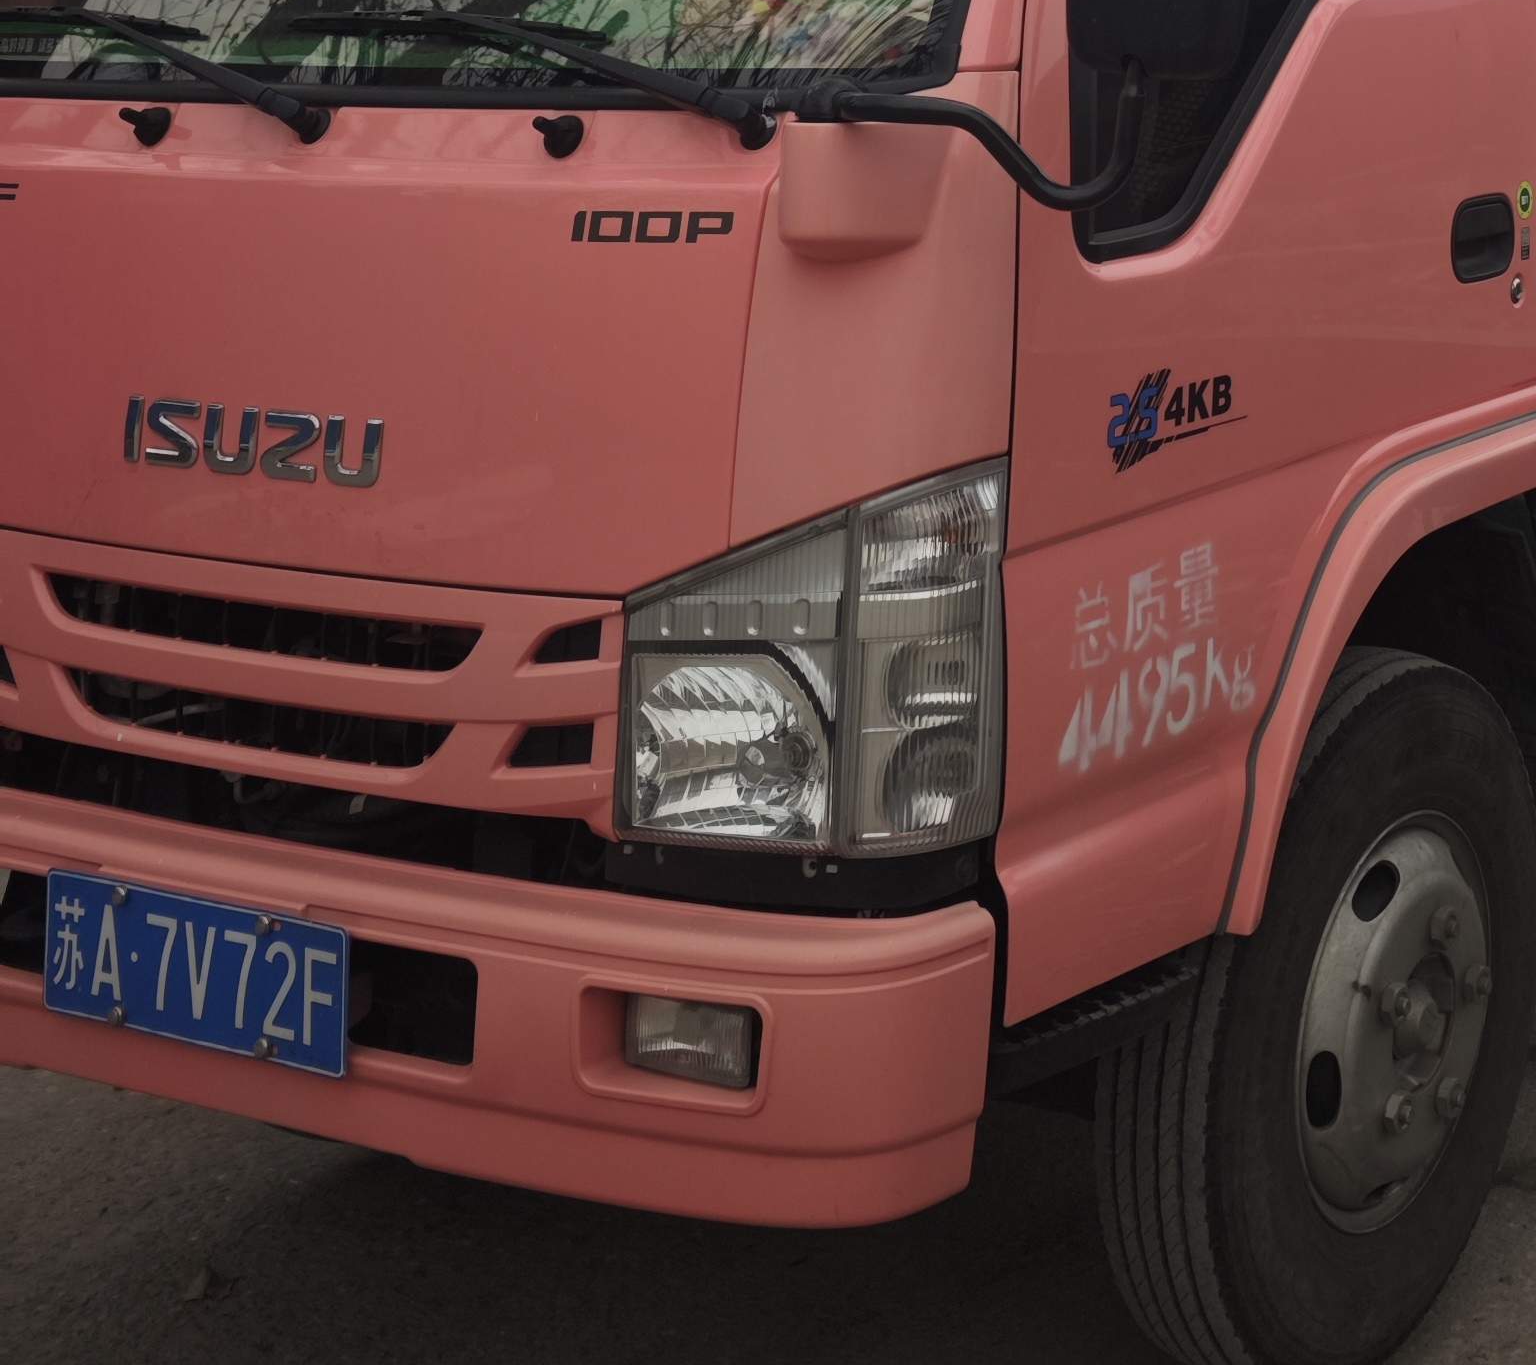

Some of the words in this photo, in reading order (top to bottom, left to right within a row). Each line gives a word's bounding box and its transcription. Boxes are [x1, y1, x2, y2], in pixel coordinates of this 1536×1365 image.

[571, 210, 734, 244] 100P
[1164, 374, 1232, 427] 4KB
[124, 394, 385, 489] ISUZU
[1070, 541, 1220, 671] 总质量
